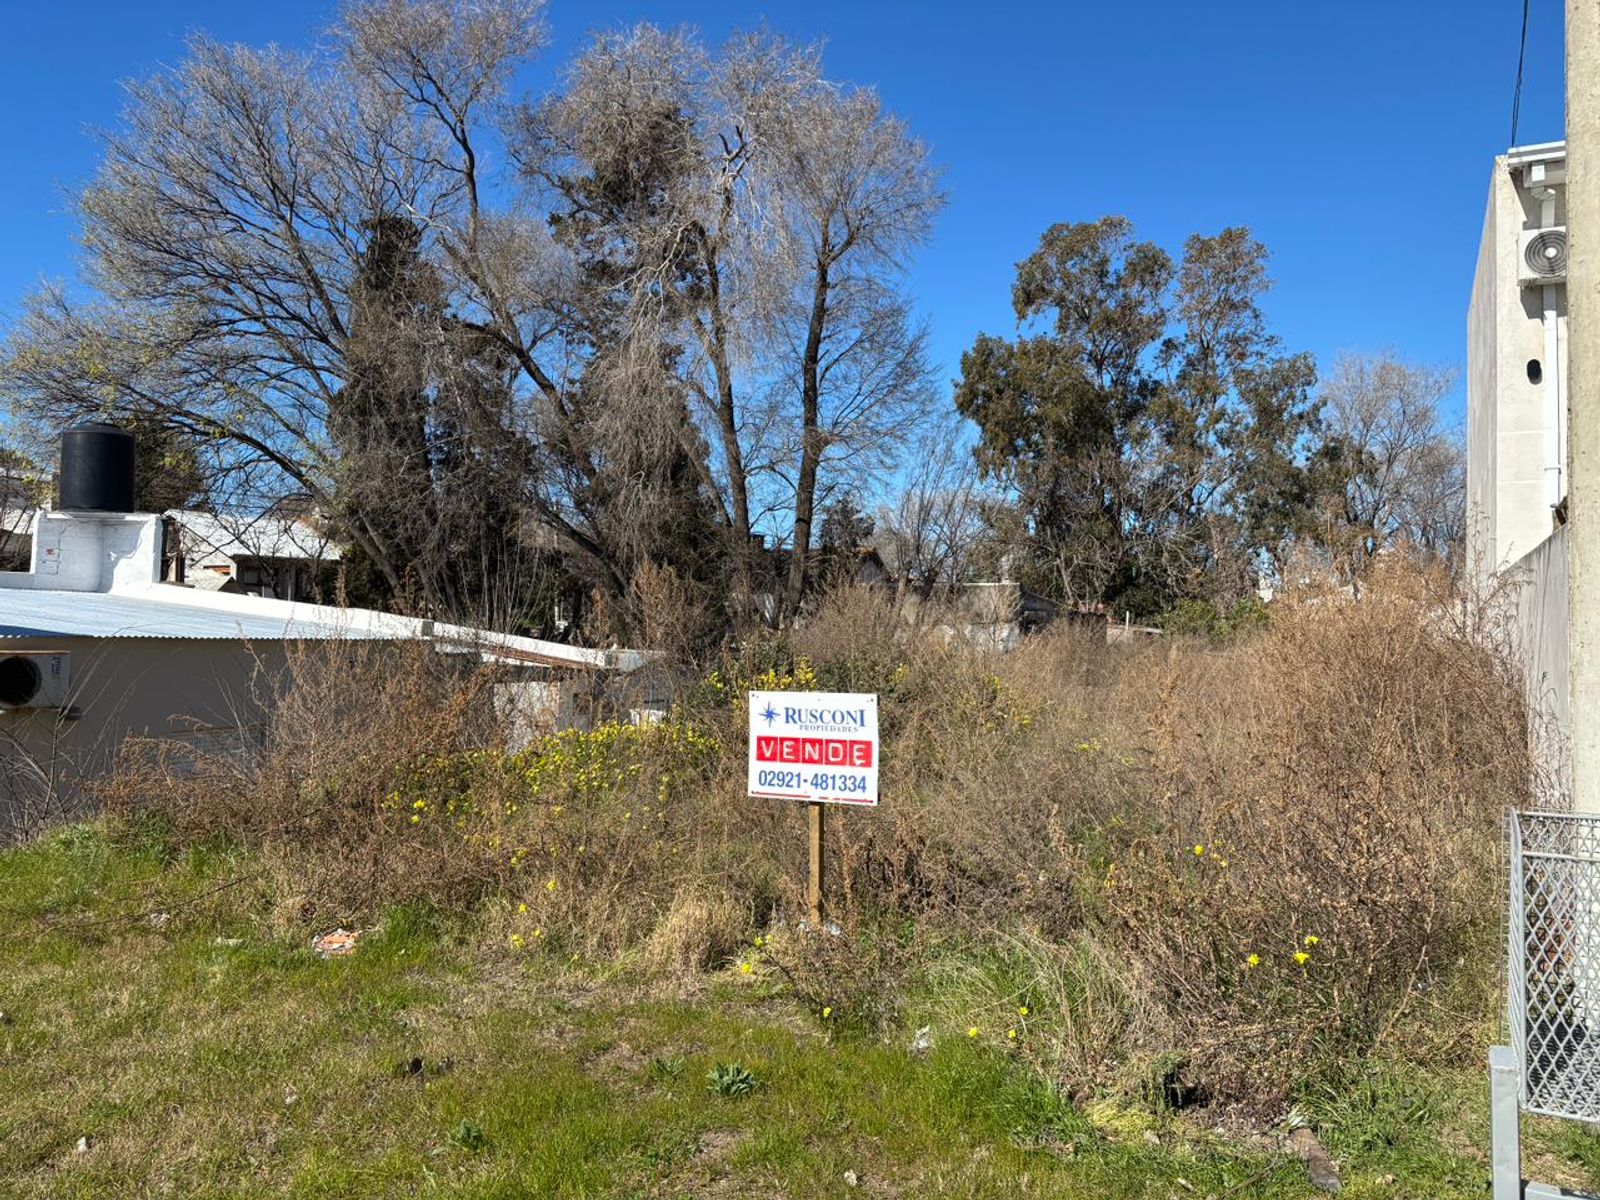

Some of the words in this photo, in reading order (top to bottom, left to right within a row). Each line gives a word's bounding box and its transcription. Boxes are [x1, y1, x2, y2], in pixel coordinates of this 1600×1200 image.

[784, 706, 866, 727] RUSCONI
[799, 724, 859, 733] PROPIEDADES
[760, 740, 867, 766] VENDE
